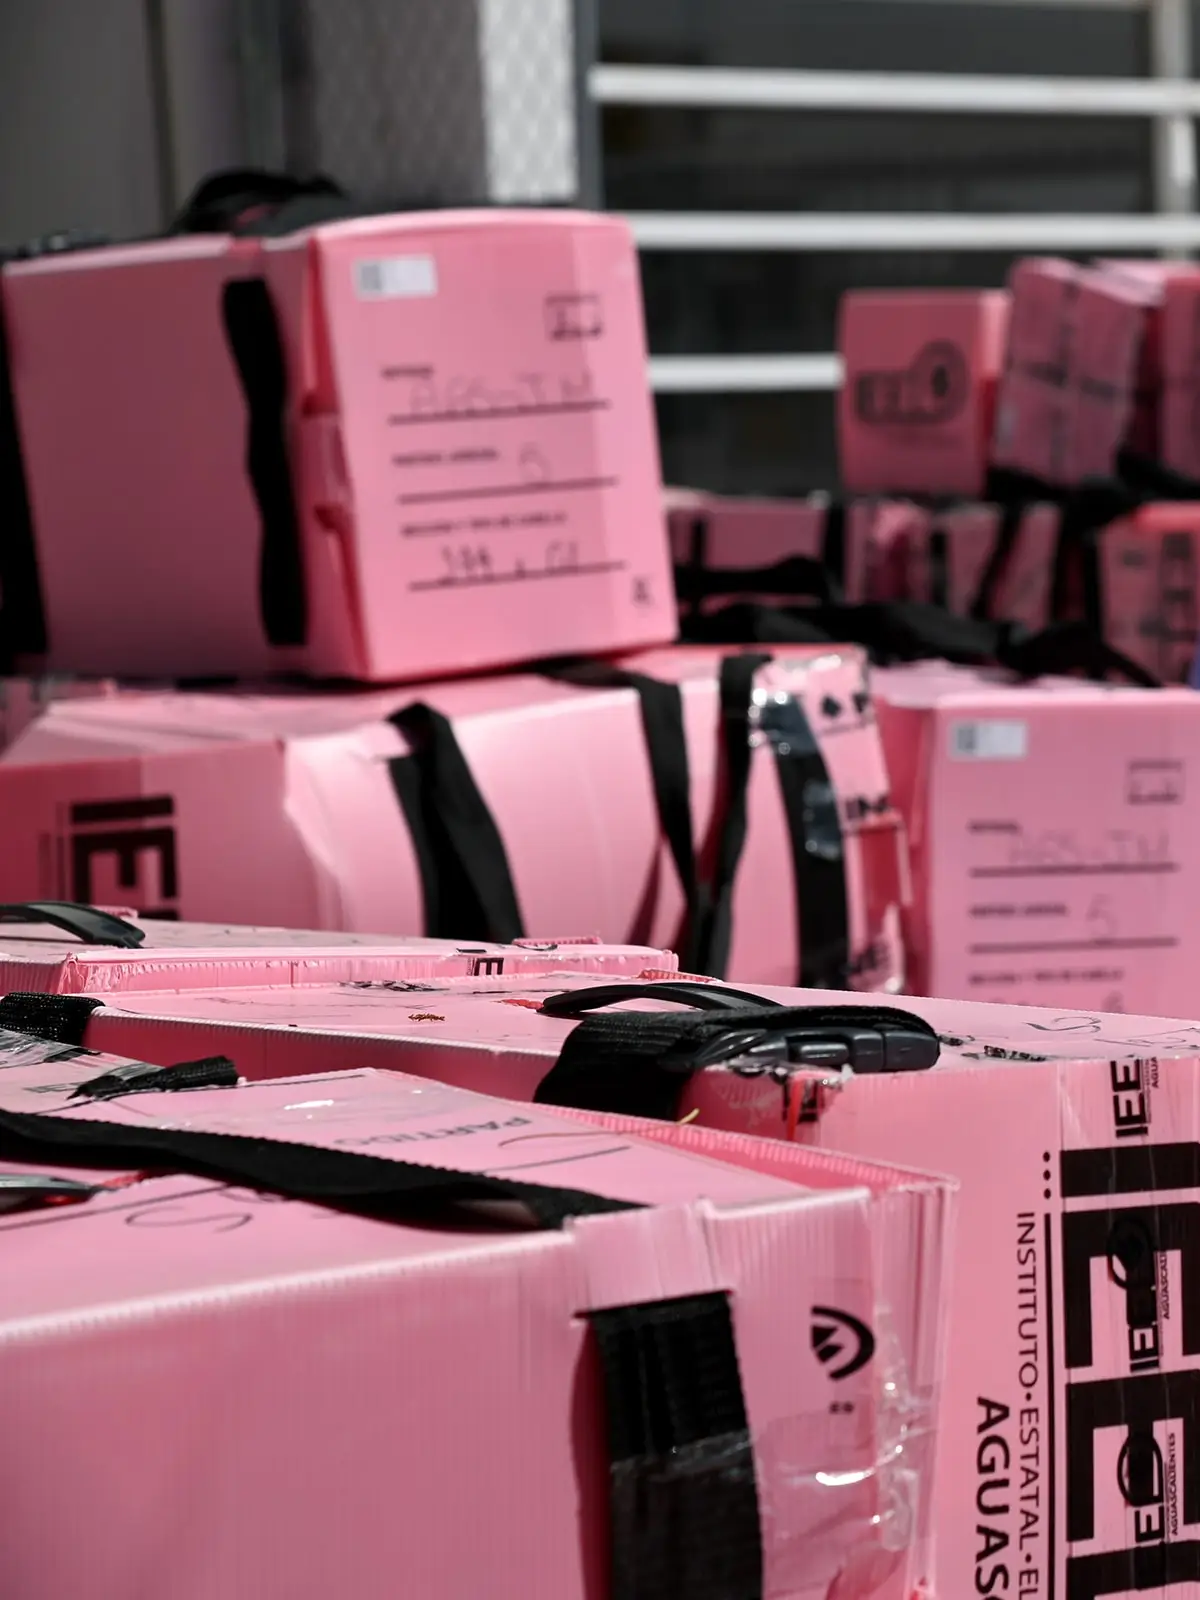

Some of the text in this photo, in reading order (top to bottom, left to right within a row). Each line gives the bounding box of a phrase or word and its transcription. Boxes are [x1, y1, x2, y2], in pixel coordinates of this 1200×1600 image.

[71, 795, 180, 920] IE
[975, 1396, 1011, 1600] AGUAS
[1019, 1407, 1040, 1551] ESTATAL
